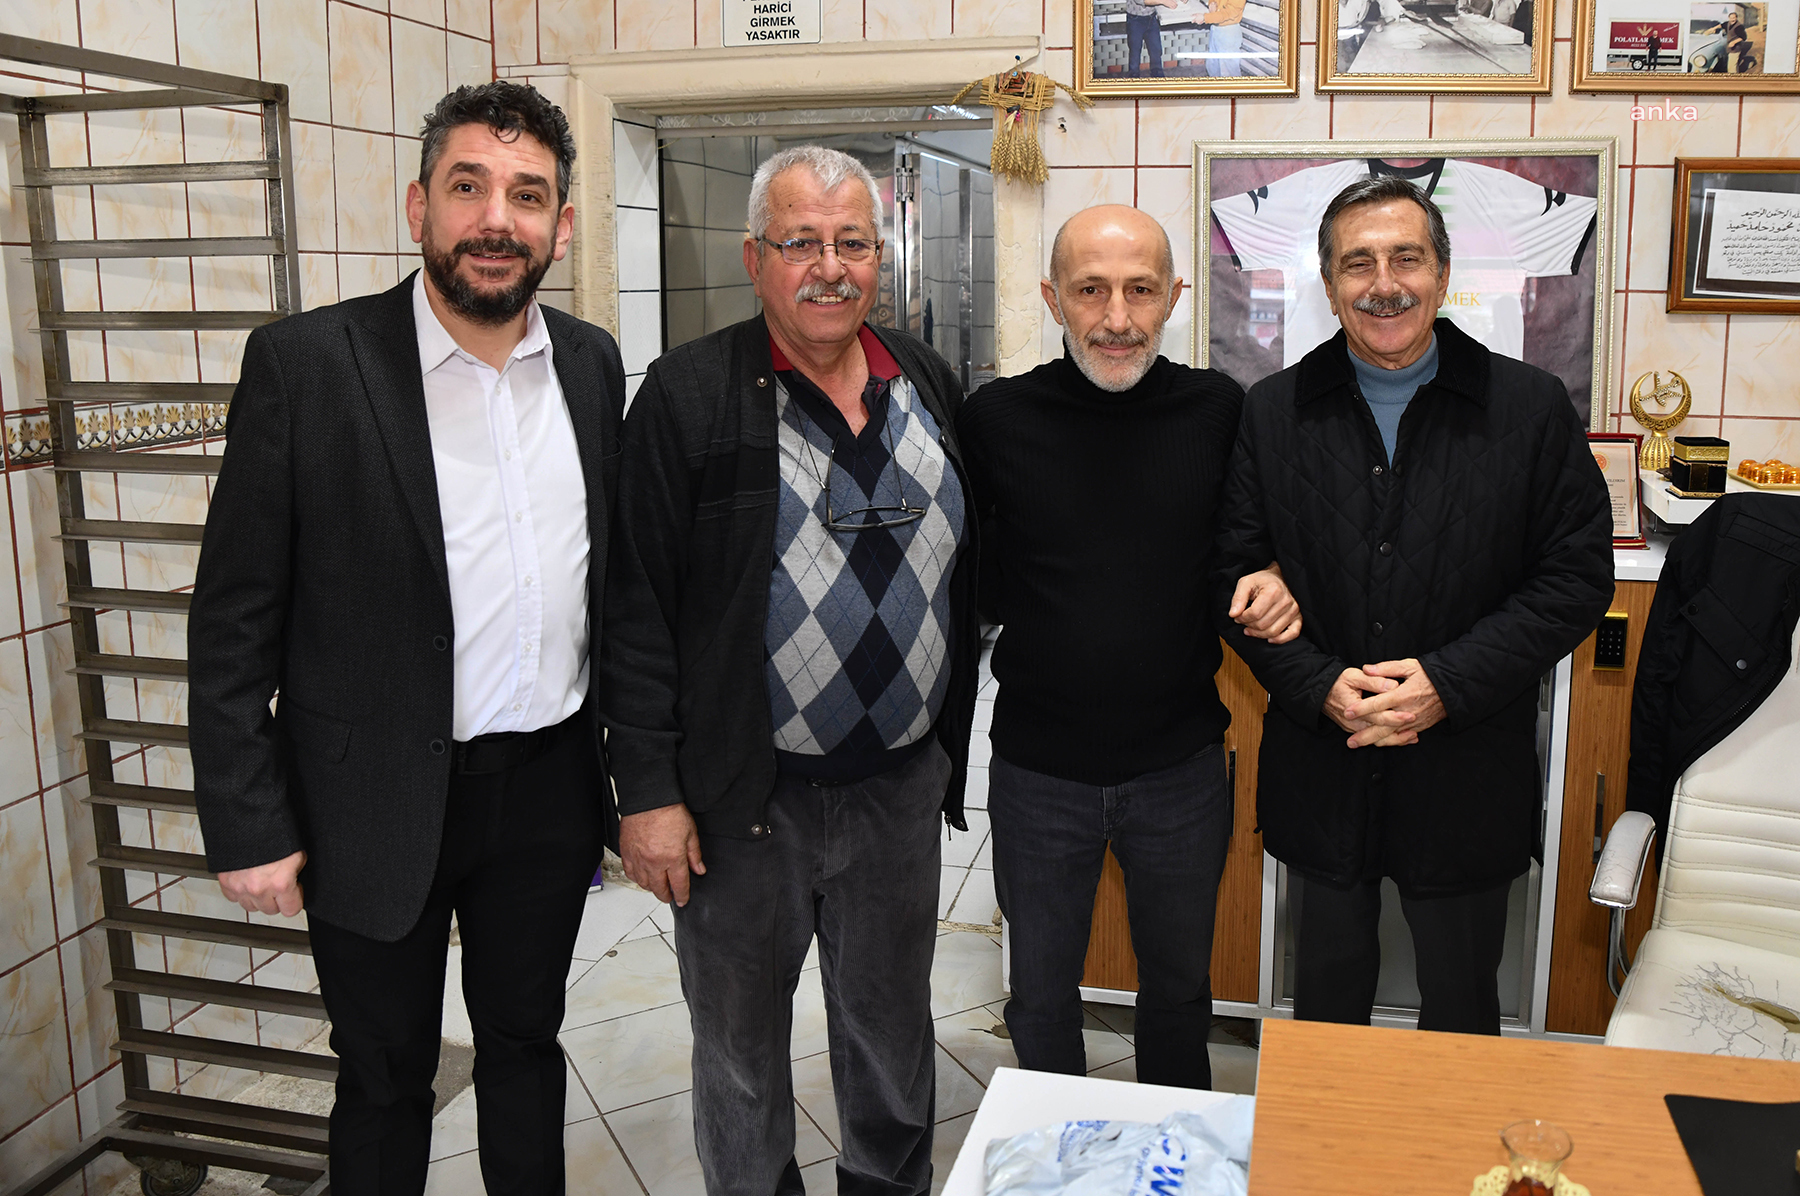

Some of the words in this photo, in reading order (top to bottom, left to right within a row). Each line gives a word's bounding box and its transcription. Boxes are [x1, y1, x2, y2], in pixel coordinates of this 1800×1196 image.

[754, 1, 791, 14] HARİCİ
[750, 15, 795, 28] GİRMEK
[745, 29, 800, 41] YASAKTIR
[1444, 292, 1481, 306] MEK
